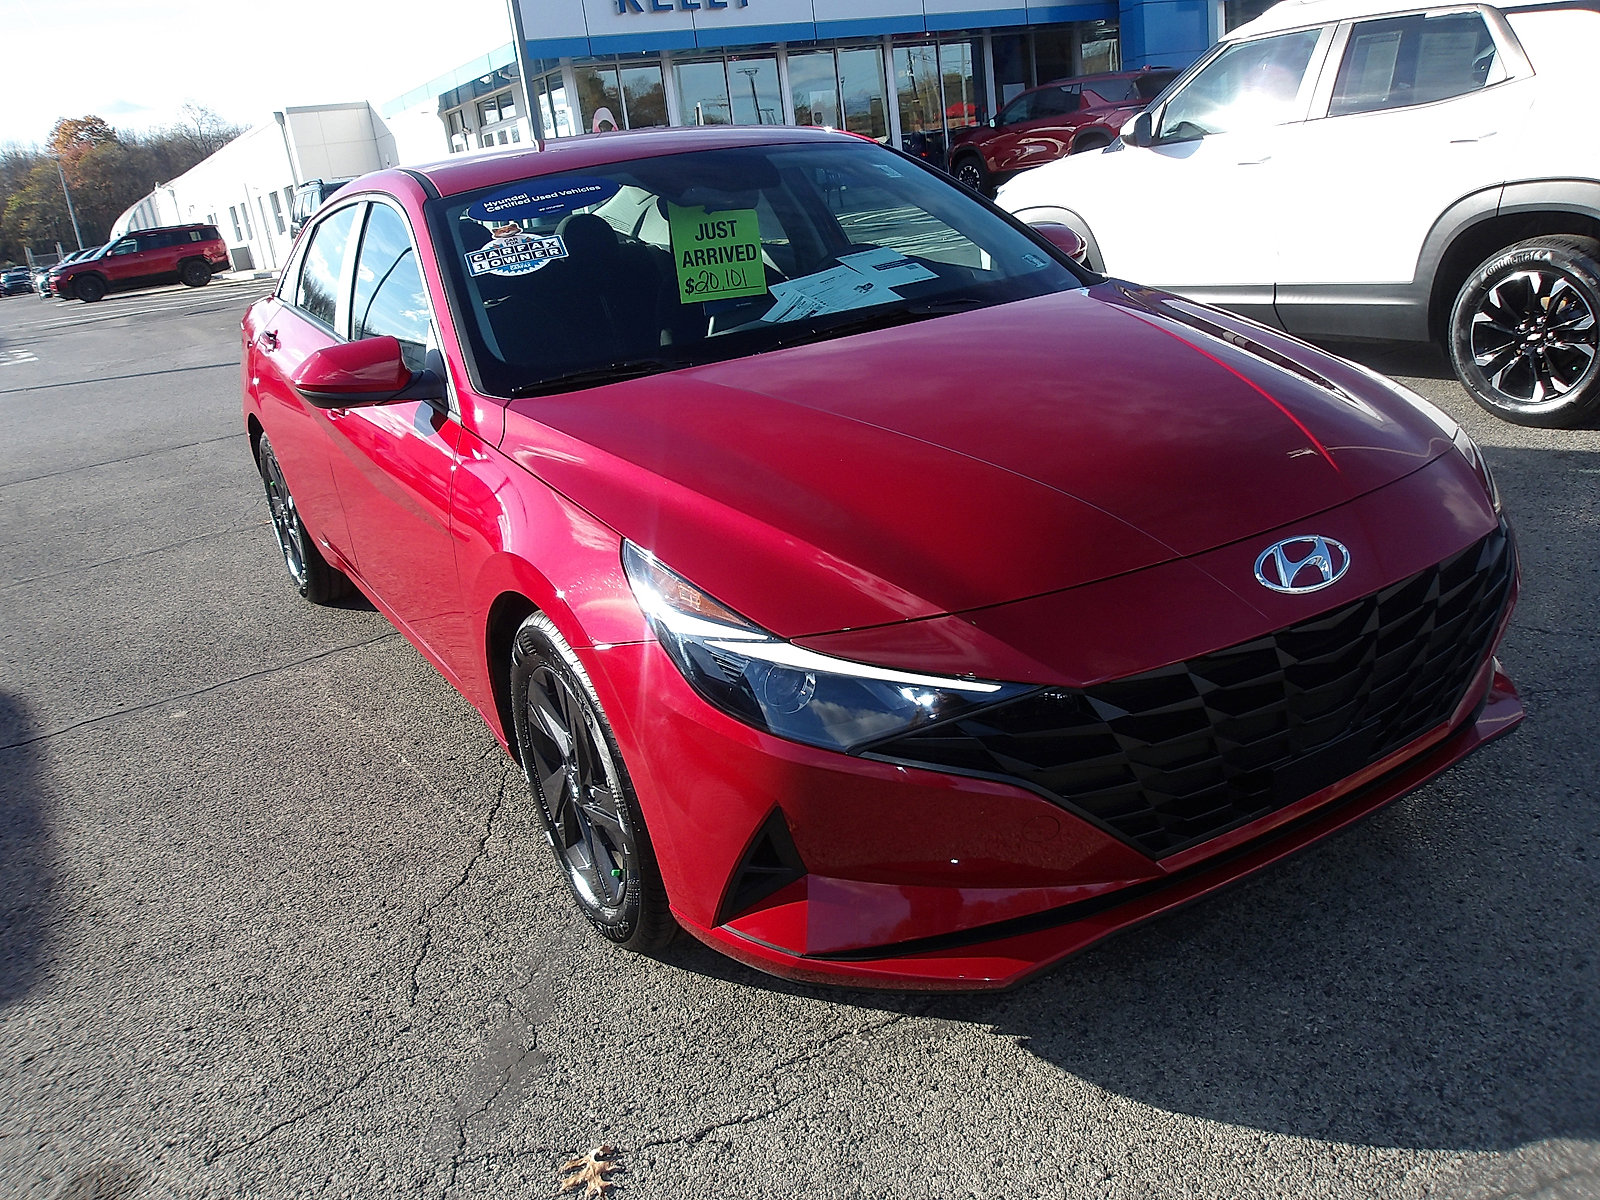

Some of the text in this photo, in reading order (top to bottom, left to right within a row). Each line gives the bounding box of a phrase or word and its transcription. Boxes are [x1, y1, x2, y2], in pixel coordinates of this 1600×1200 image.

[483, 193, 528, 208] Hyundai
[486, 198, 531, 213] Certified
[532, 192, 558, 202] Used
[558, 185, 601, 197] Vehicles
[695, 220, 737, 241] JUST
[473, 240, 557, 262] CARFAX
[489, 248, 562, 267] OWNER
[683, 244, 757, 268] ARRIVED
[1486, 251, 1535, 276] Continental
